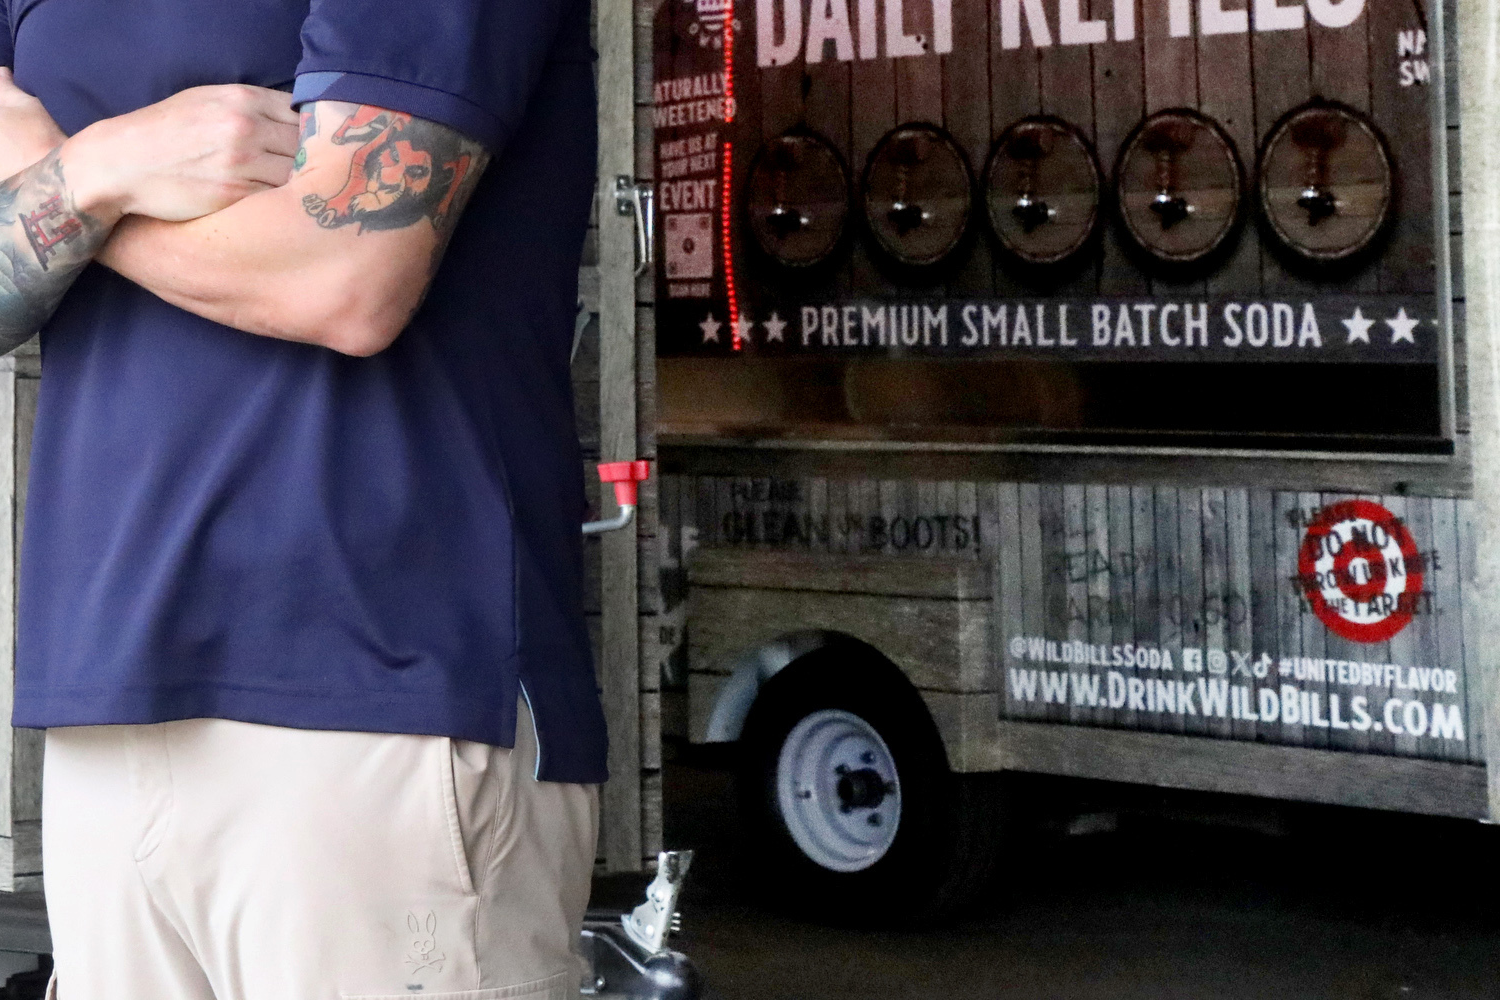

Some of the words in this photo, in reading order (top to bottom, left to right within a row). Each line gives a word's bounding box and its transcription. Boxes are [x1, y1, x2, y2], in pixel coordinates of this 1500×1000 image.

[654, 97, 738, 128] WEETENED
[660, 180, 717, 212] EVENT
[800, 306, 949, 348] PREMIUM
[961, 305, 1083, 348] SMALL
[1092, 304, 1208, 348] BATCH
[1223, 302, 1323, 348] SODA
[1278, 657, 1458, 693] #UNITEDBYFLAVOR
